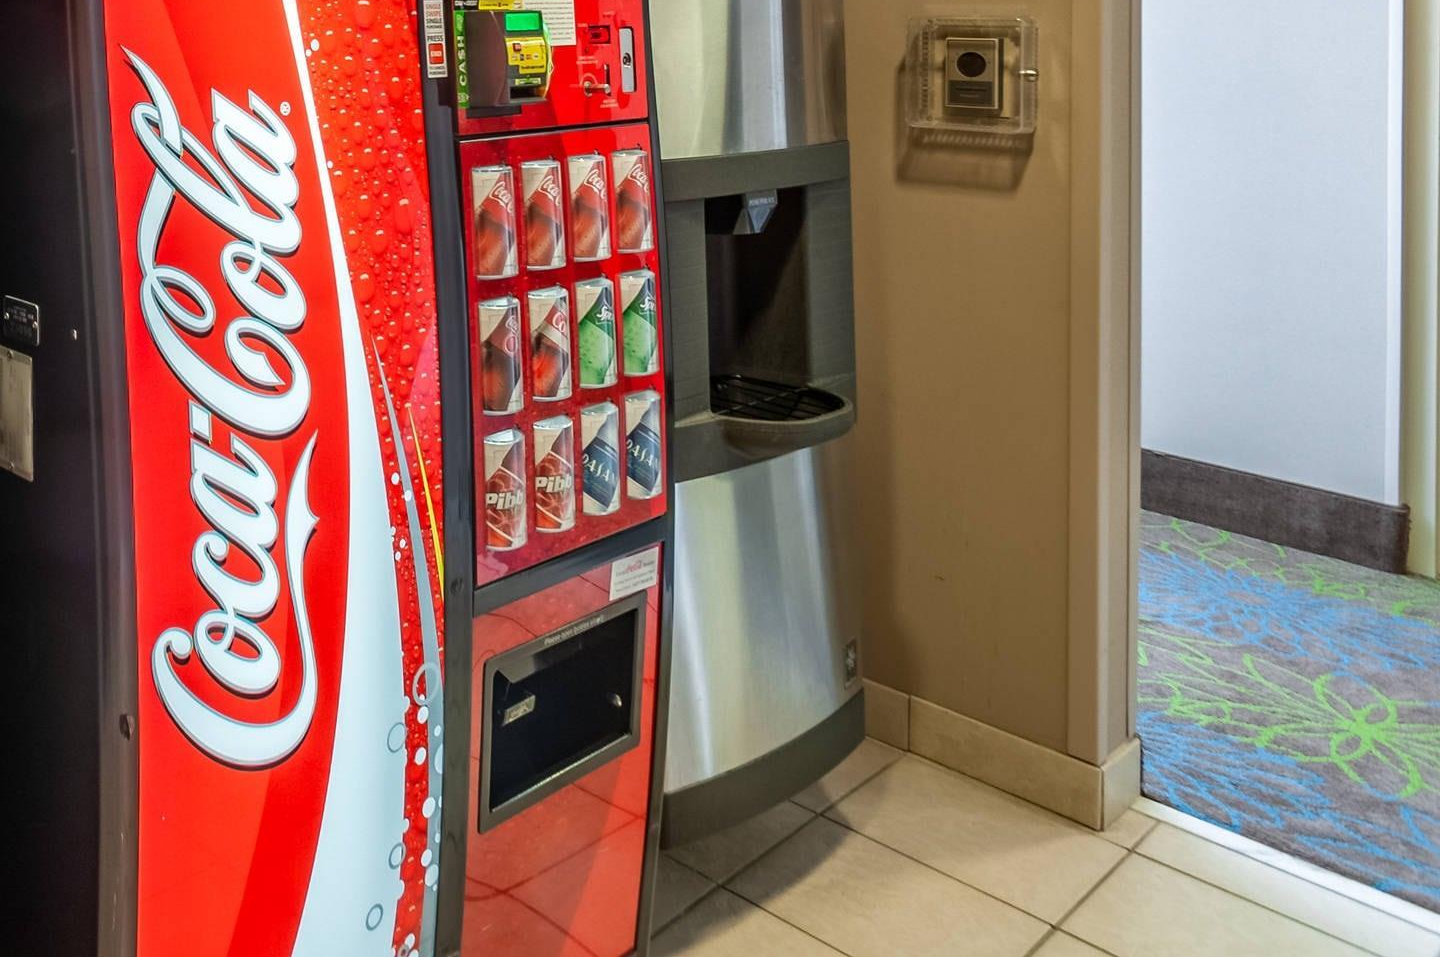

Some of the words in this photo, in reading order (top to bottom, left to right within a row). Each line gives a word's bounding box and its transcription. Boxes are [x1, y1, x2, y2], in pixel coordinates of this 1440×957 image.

[457, 35, 467, 86] CASH
[121, 46, 318, 768] Coca-Cola
[486, 488, 523, 510] Pibb
[536, 473, 572, 493] Pibb
